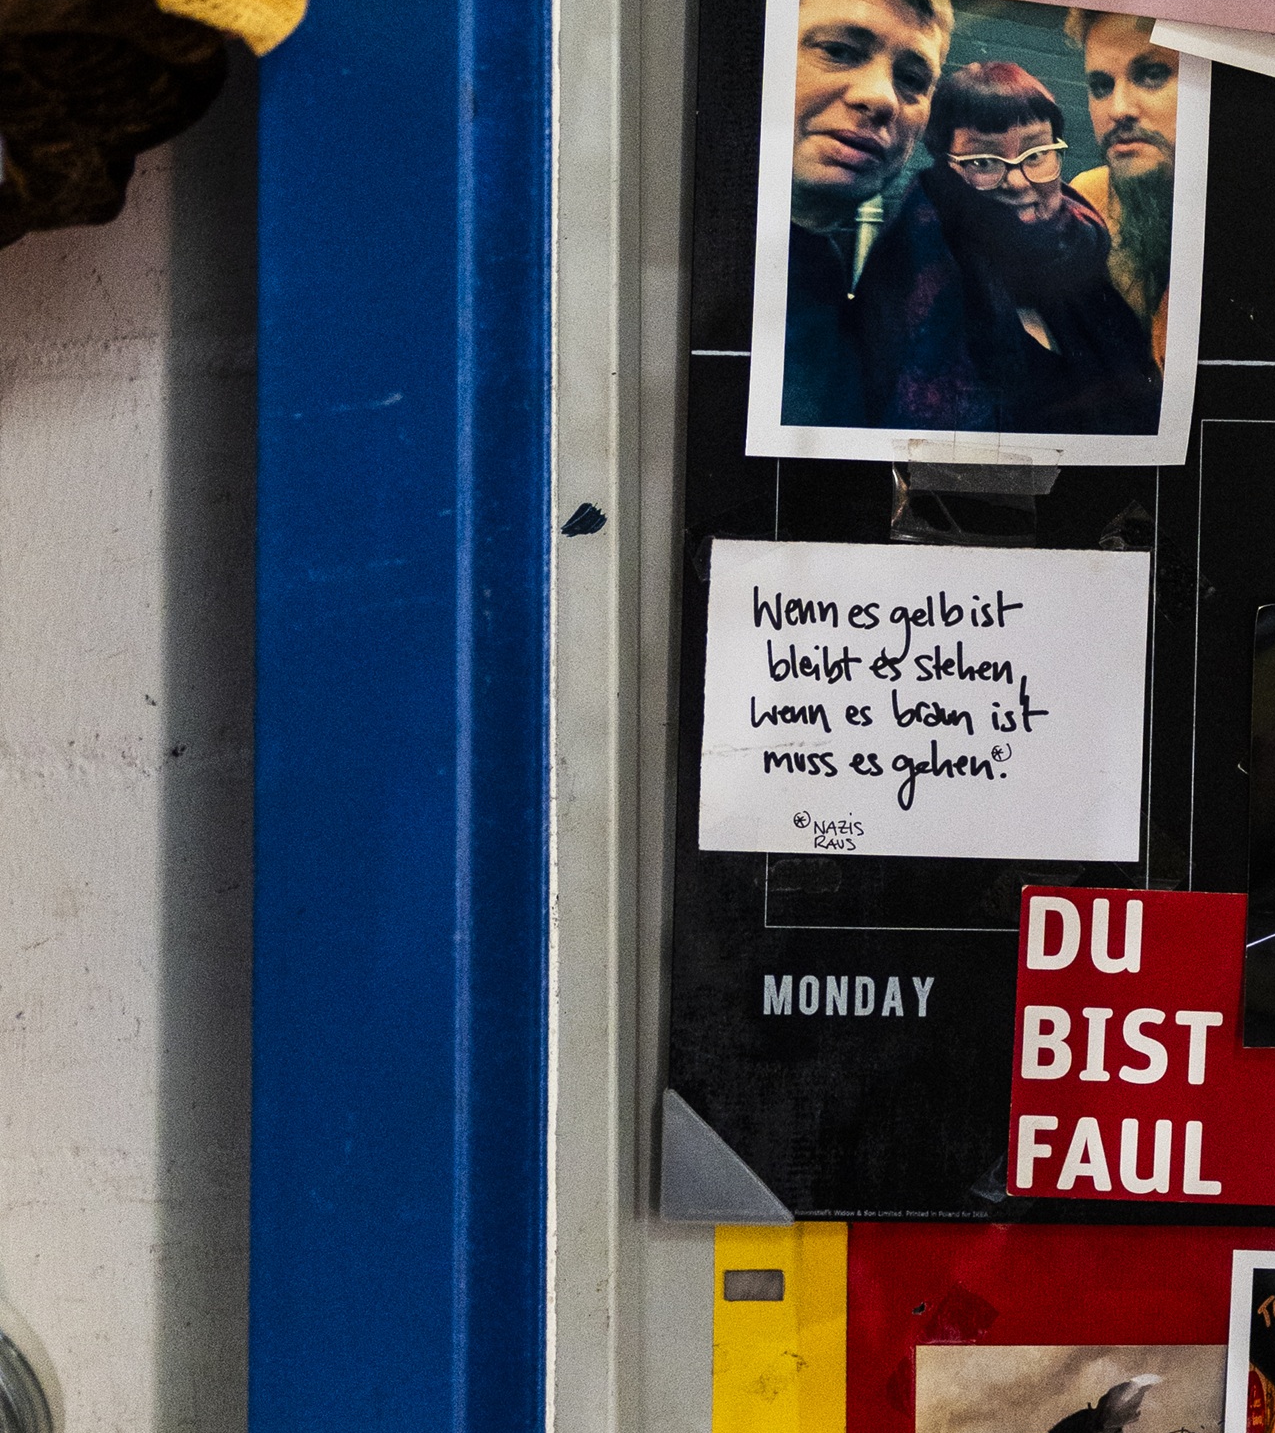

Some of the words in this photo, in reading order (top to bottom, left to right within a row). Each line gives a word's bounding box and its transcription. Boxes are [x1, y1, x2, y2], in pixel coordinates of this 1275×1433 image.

[848, 603, 880, 629] es
[971, 590, 1024, 627] ist
[767, 639, 862, 684] bleibt
[870, 647, 900, 682] es
[846, 705, 872, 726] es
[892, 689, 974, 735] braun
[992, 675, 1049, 733] ist
[764, 751, 838, 777] muss
[850, 753, 883, 777] es
[814, 835, 856, 851] RAUS
[1025, 896, 1144, 973] DU
[763, 975, 934, 1017] MONDAY
[1021, 1005, 1223, 1085] BIST
[1015, 1114, 1222, 1195] FAUL
